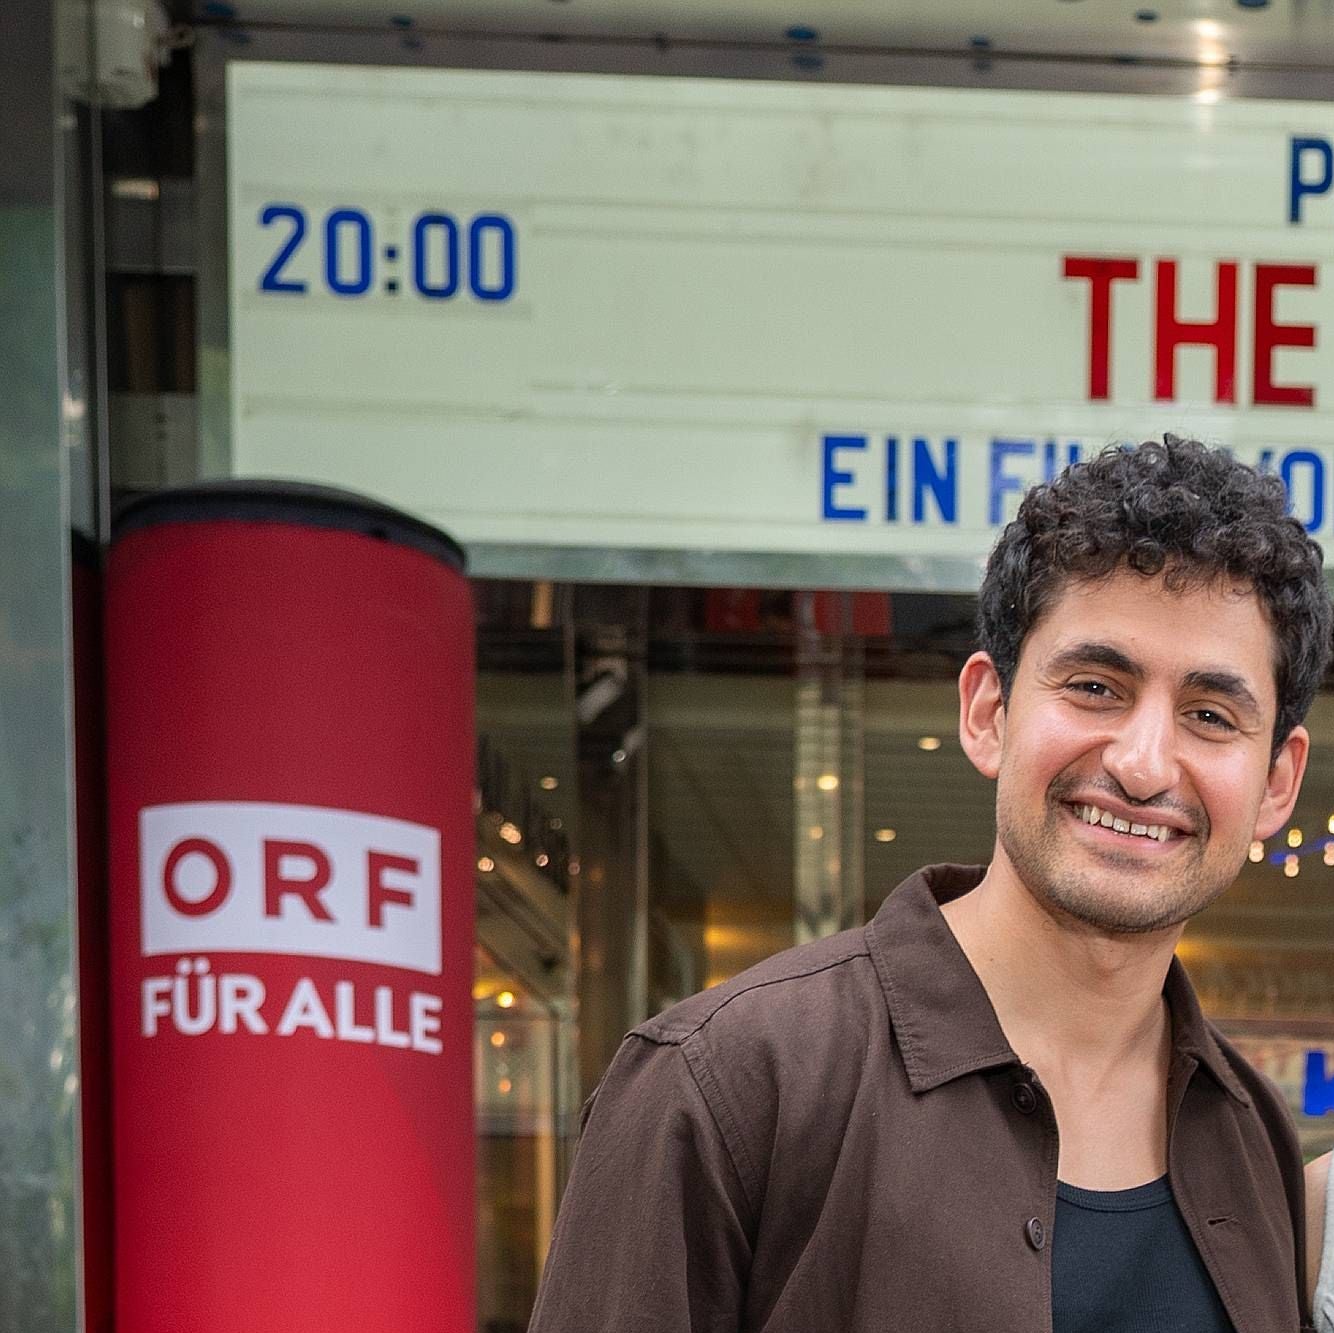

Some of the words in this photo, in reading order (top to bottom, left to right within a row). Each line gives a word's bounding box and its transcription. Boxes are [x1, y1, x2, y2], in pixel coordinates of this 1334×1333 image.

[258, 204, 518, 302] 20:00
[1062, 255, 1317, 407] THE
[821, 434, 959, 525] EIN
[988, 438, 1130, 524] FI
[162, 838, 421, 929] ORF
[141, 958, 270, 1038] FÜR
[276, 976, 444, 1056] ALLE
